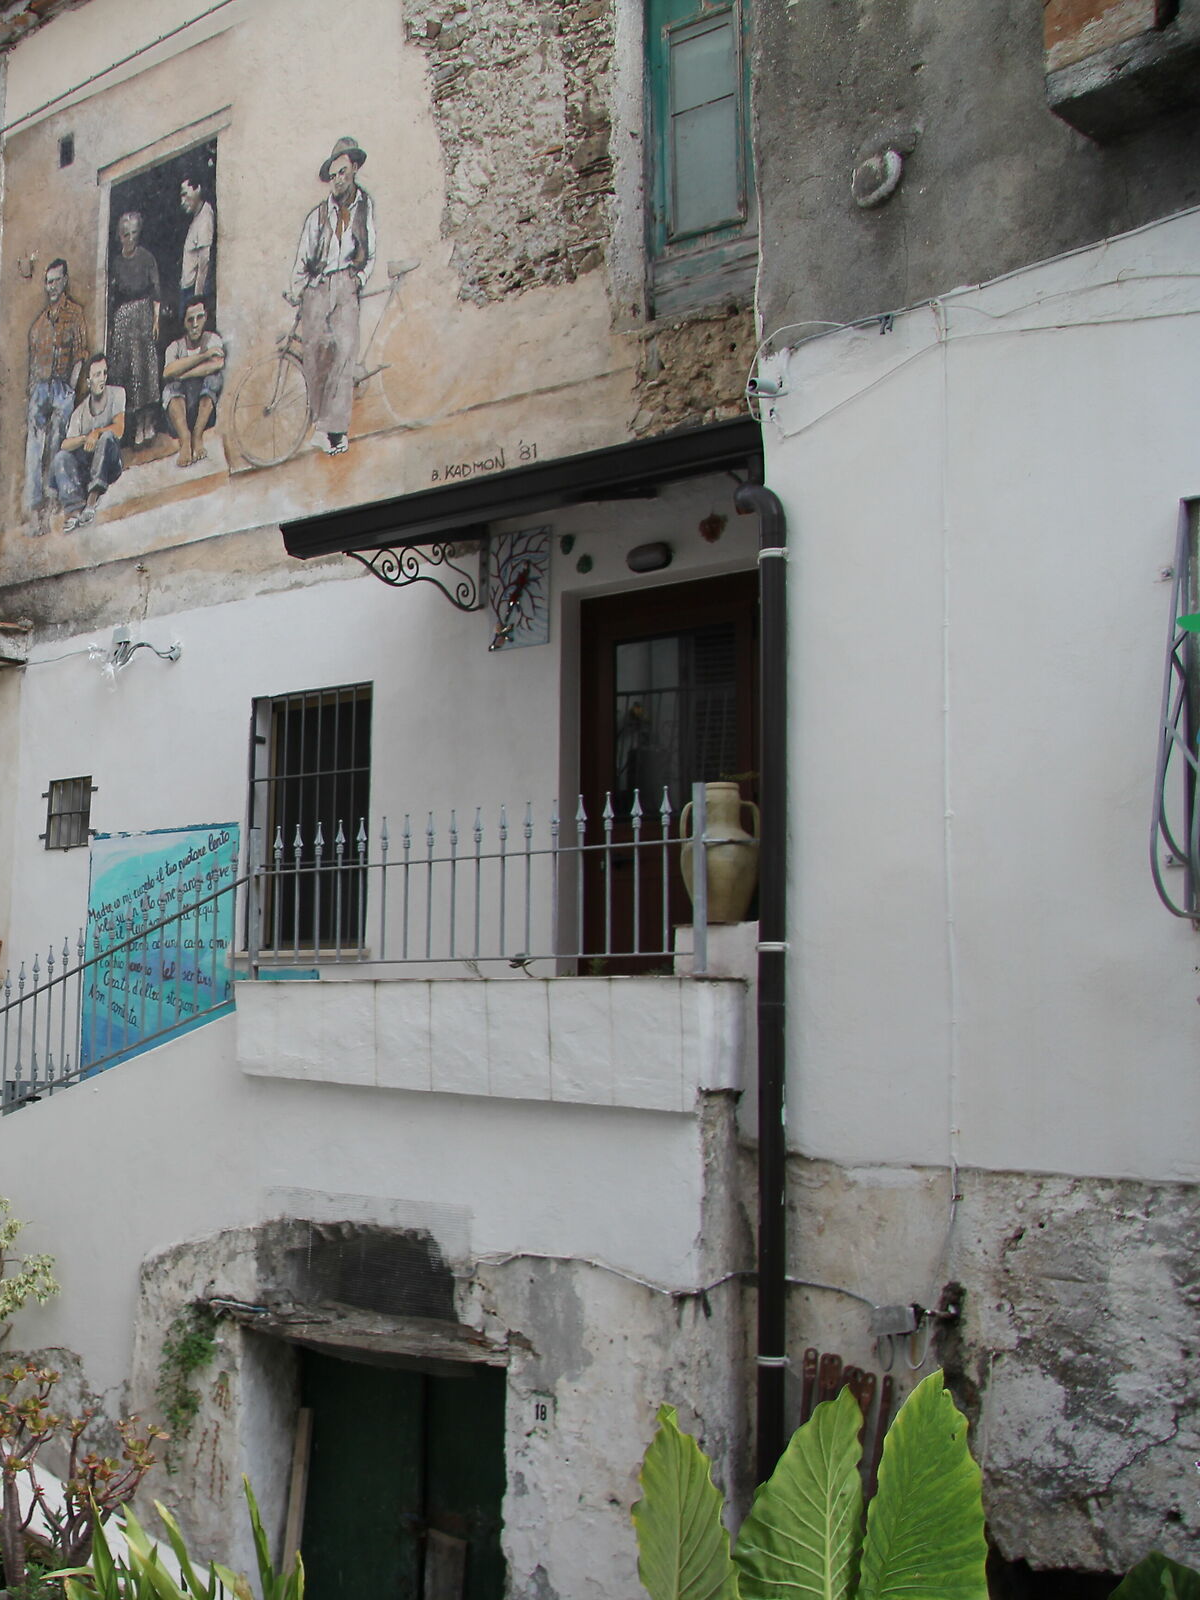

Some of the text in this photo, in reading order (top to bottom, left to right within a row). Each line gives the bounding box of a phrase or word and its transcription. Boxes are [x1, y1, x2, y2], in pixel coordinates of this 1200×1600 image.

[445, 447, 506, 481] KADMON
[88, 901, 113, 924] Madre
[155, 866, 164, 882] il
[165, 859, 177, 876] tuo
[178, 845, 207, 869] nuotare
[208, 830, 230, 852] lento
[184, 938, 205, 949] caa
[535, 1403, 548, 1421] 18
